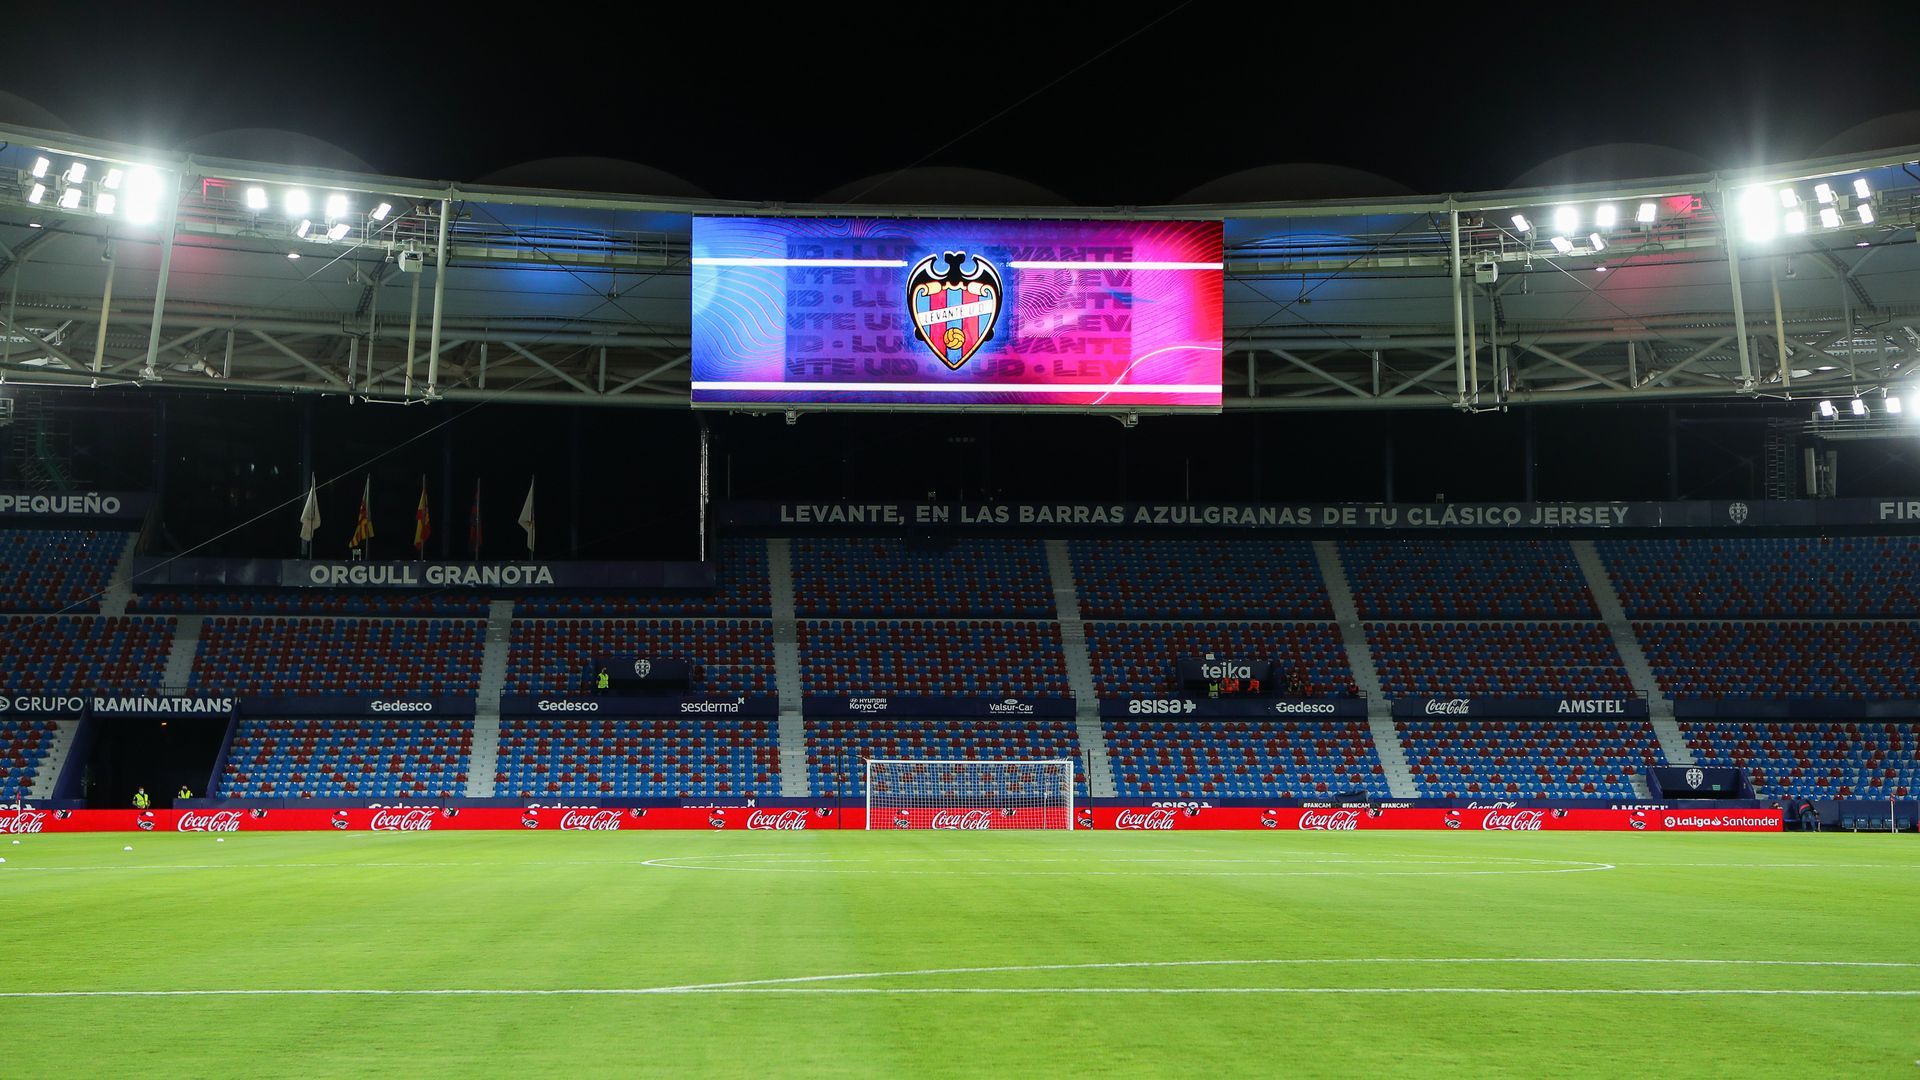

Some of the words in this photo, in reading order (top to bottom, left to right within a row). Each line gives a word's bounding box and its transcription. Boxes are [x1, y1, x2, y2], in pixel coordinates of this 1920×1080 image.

[0, 492, 121, 514] PEQUEÑO
[780, 505, 905, 525] LEVANTE,
[916, 506, 949, 522] EN
[961, 506, 1010, 522] LAS
[1019, 506, 1125, 523] BARRAS
[1133, 506, 1312, 524] AZULGRANAS
[1323, 507, 1357, 524] DE
[1365, 508, 1398, 525] TU
[1407, 504, 1522, 525] CLÁSICO
[1529, 507, 1629, 525] JERSEY
[310, 565, 418, 584] ORGULL
[426, 565, 554, 584] GRANOTA
[1201, 662, 1250, 678] teika
[15, 697, 84, 711] GRUPO
[93, 698, 232, 712] RAMINATRANS
[371, 700, 433, 711] Gedesco
[538, 700, 599, 711] Gedesco
[681, 701, 739, 713] sesderma
[849, 702, 872, 710] Koryo
[873, 702, 888, 710] Car
[989, 703, 1034, 711] Valsur-Car
[1276, 702, 1335, 713] Gedesco
[1425, 699, 1470, 714] Coca-Cola
[1558, 700, 1624, 713] AMSTEL
[178, 812, 243, 832] Coca-Cola
[371, 810, 435, 831] Coca-Cola
[561, 811, 624, 831] Coca-Cola
[747, 810, 808, 830] Coca-Cola
[932, 810, 993, 830] Coca-Cola
[1116, 810, 1177, 830] Coca-Cola
[1299, 811, 1360, 831] Coca-Cola
[1482, 810, 1543, 831] Coca-Cola
[1676, 817, 1711, 828] LaLiga
[1722, 816, 1780, 827] Santander
